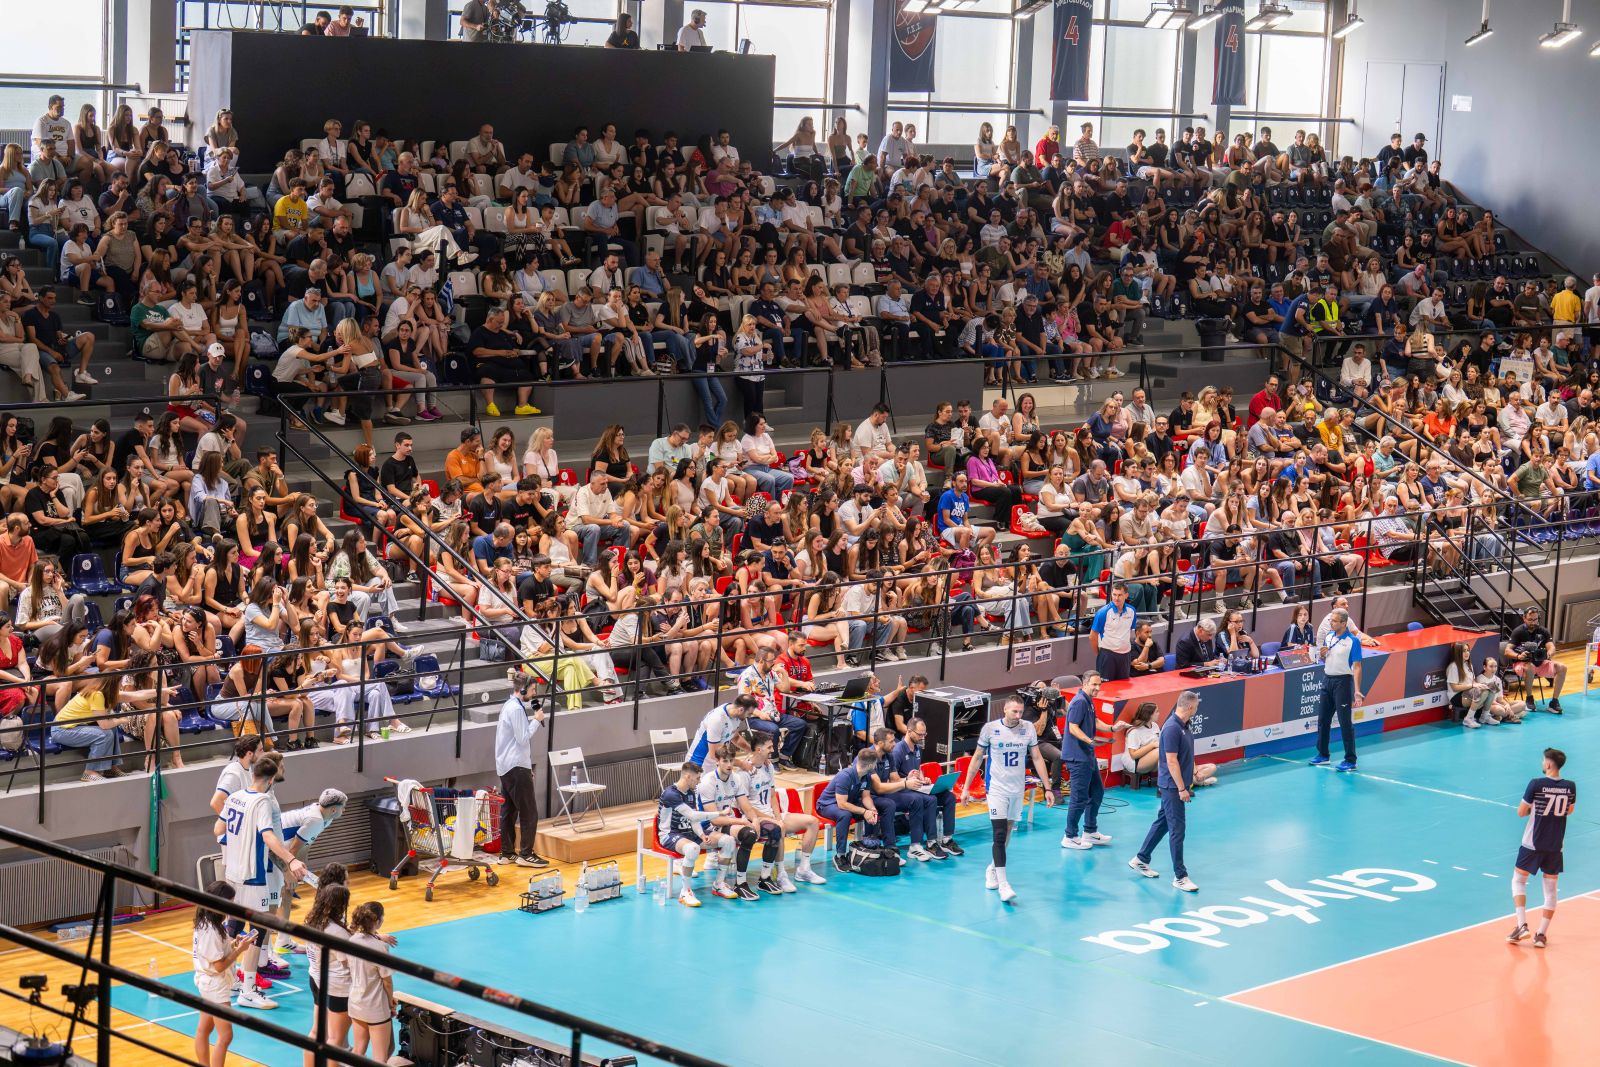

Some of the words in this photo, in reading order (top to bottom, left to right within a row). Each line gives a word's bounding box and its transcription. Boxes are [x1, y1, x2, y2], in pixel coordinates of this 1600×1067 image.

[1064, 16, 1079, 45] 4
[1225, 25, 1238, 52] 4
[1302, 672, 1314, 682] CEV
[1300, 704, 1313, 715] 2026
[1003, 751, 1019, 767] 12
[759, 789, 769, 805] 17
[1543, 794, 1568, 816] 70
[228, 808, 244, 836] 27
[261, 898, 269, 907] 27
[270, 892, 278, 900] 18
[1080, 867, 1438, 955] Glyfada
